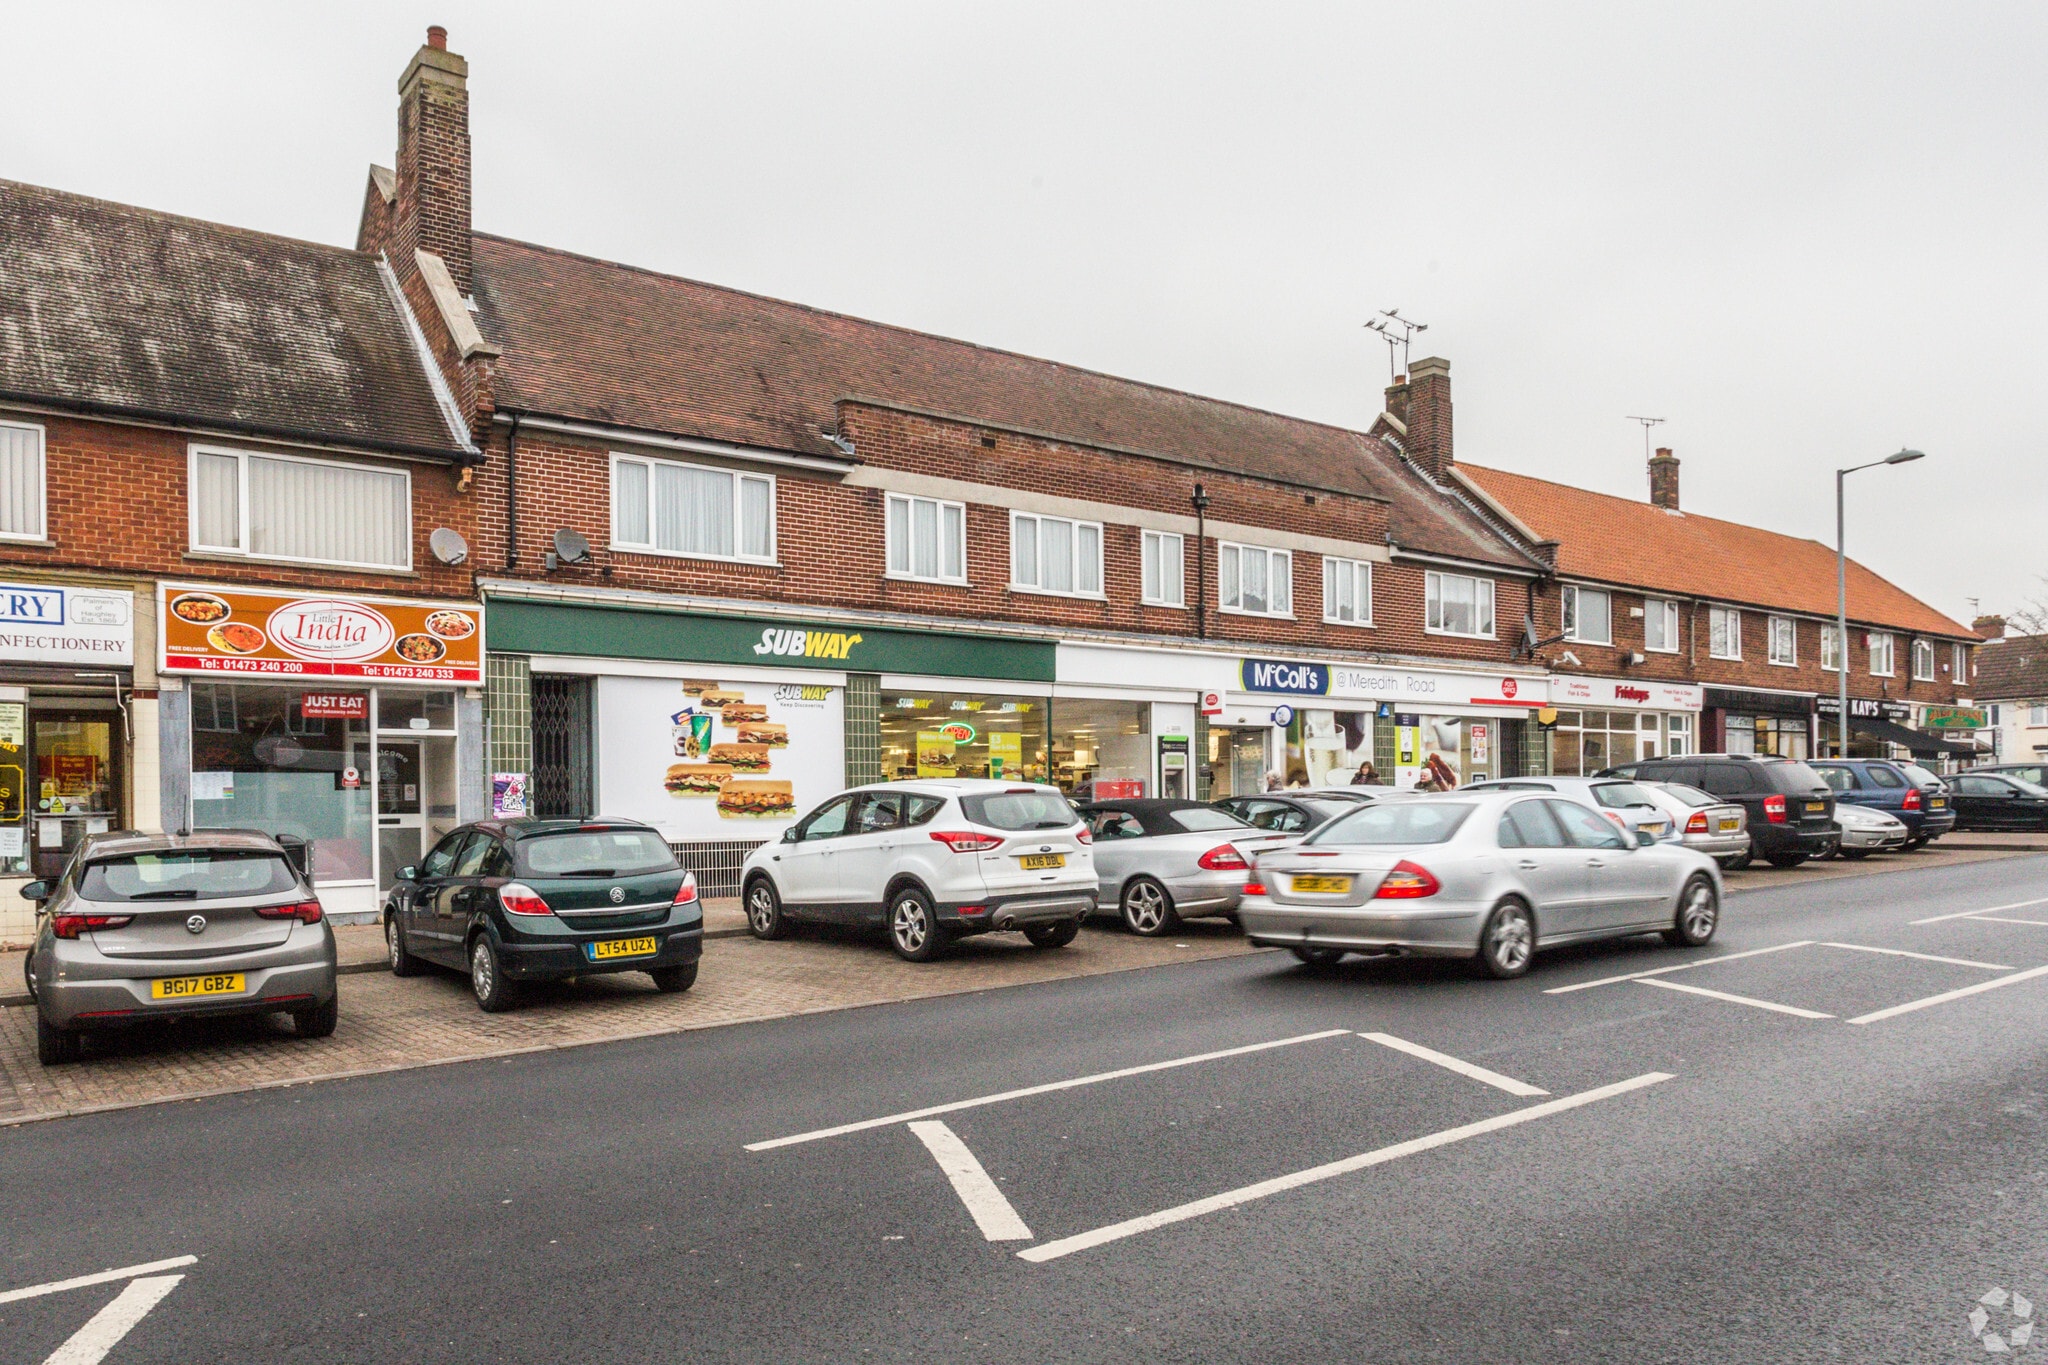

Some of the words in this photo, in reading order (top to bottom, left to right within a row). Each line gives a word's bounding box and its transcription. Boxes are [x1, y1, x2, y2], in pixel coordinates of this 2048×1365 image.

[313, 613, 336, 623] Little
[294, 613, 367, 642] India
[753, 628, 863, 659] SUBWAY
[199, 658, 220, 669] Tel:
[223, 659, 257, 671] 01473
[260, 661, 280, 672] 240
[283, 662, 303, 672] 200
[362, 665, 381, 676] Tel:
[383, 666, 414, 677] 01473
[416, 668, 434, 678] 240
[436, 669, 454, 679] 333
[1254, 663, 1318, 690] McColl's
[1337, 671, 1347, 688] @
[1350, 672, 1398, 690] Meredith
[1407, 676, 1435, 692] Road
[774, 685, 833, 701] SUBWAY
[305, 695, 338, 708] JUST
[340, 697, 364, 709] EAT
[896, 698, 934, 709] SUBWAY
[950, 700, 986, 711] SUBWAY
[1000, 702, 1034, 713] SUBWAY
[1851, 699, 1879, 717] KAY'S
[945, 726, 971, 740] OPEN
[1026, 857, 1045, 867] AX16
[596, 940, 628, 956] LT54
[631, 937, 654, 952] UZX
[163, 979, 199, 995] BG17
[203, 976, 235, 991] GBZ
